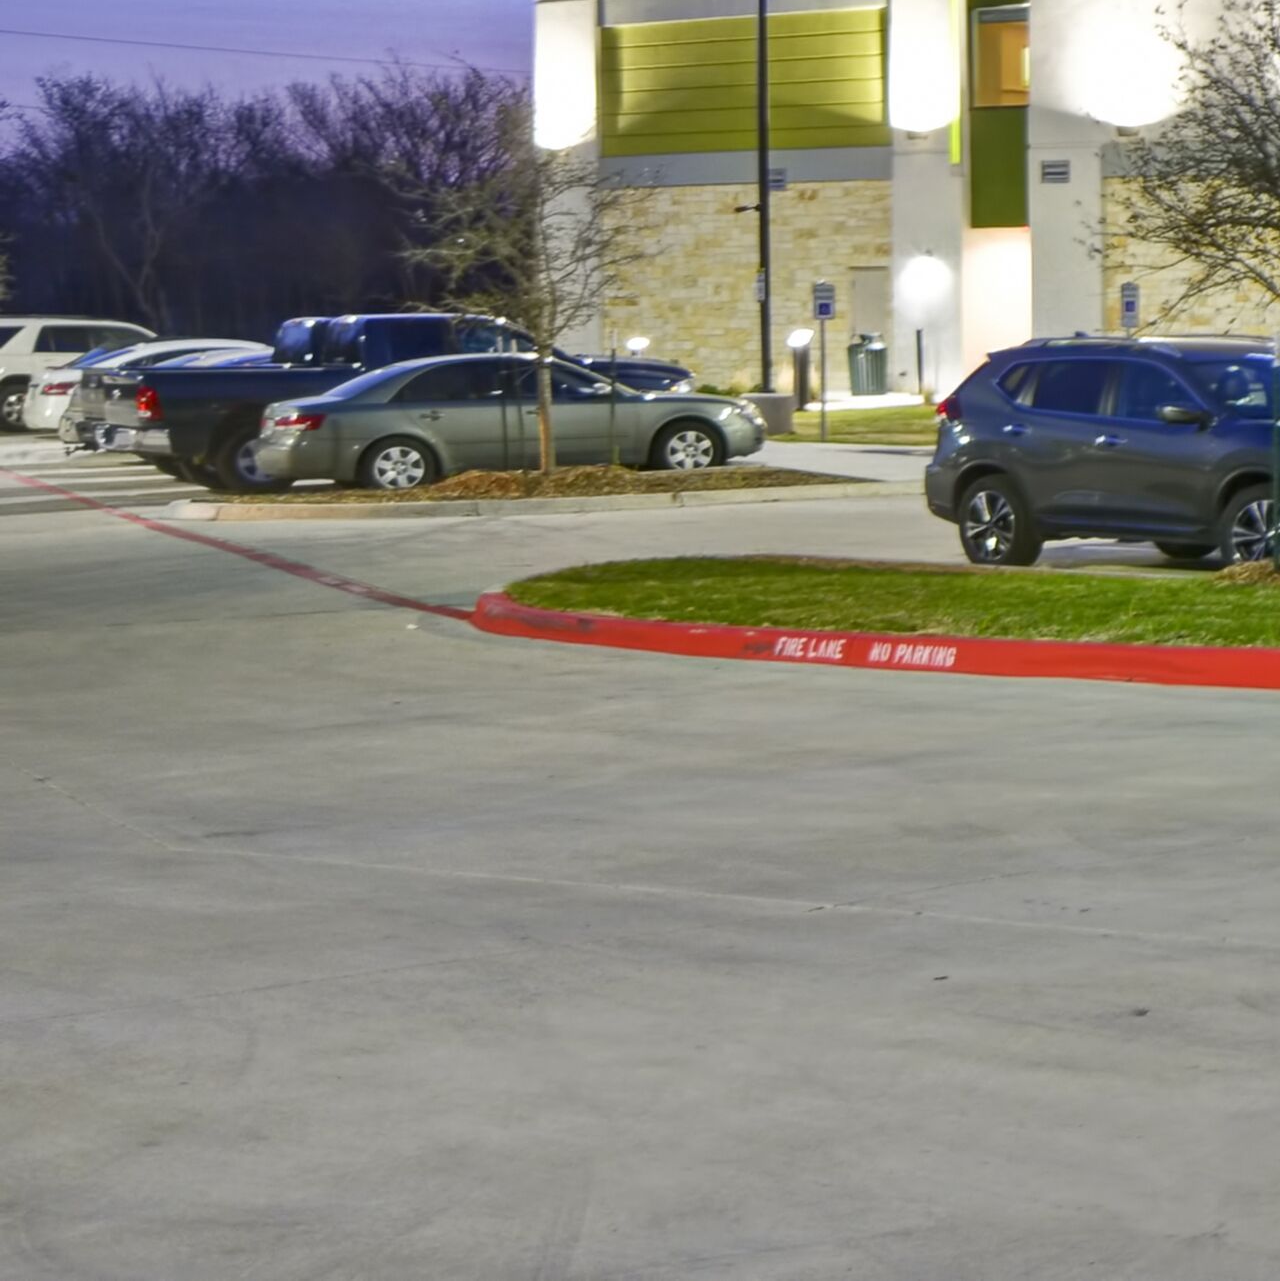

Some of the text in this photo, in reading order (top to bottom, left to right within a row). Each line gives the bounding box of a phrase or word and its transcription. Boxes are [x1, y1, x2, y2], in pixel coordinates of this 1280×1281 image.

[774, 636, 957, 667] FIRE LANE NO PARKING
